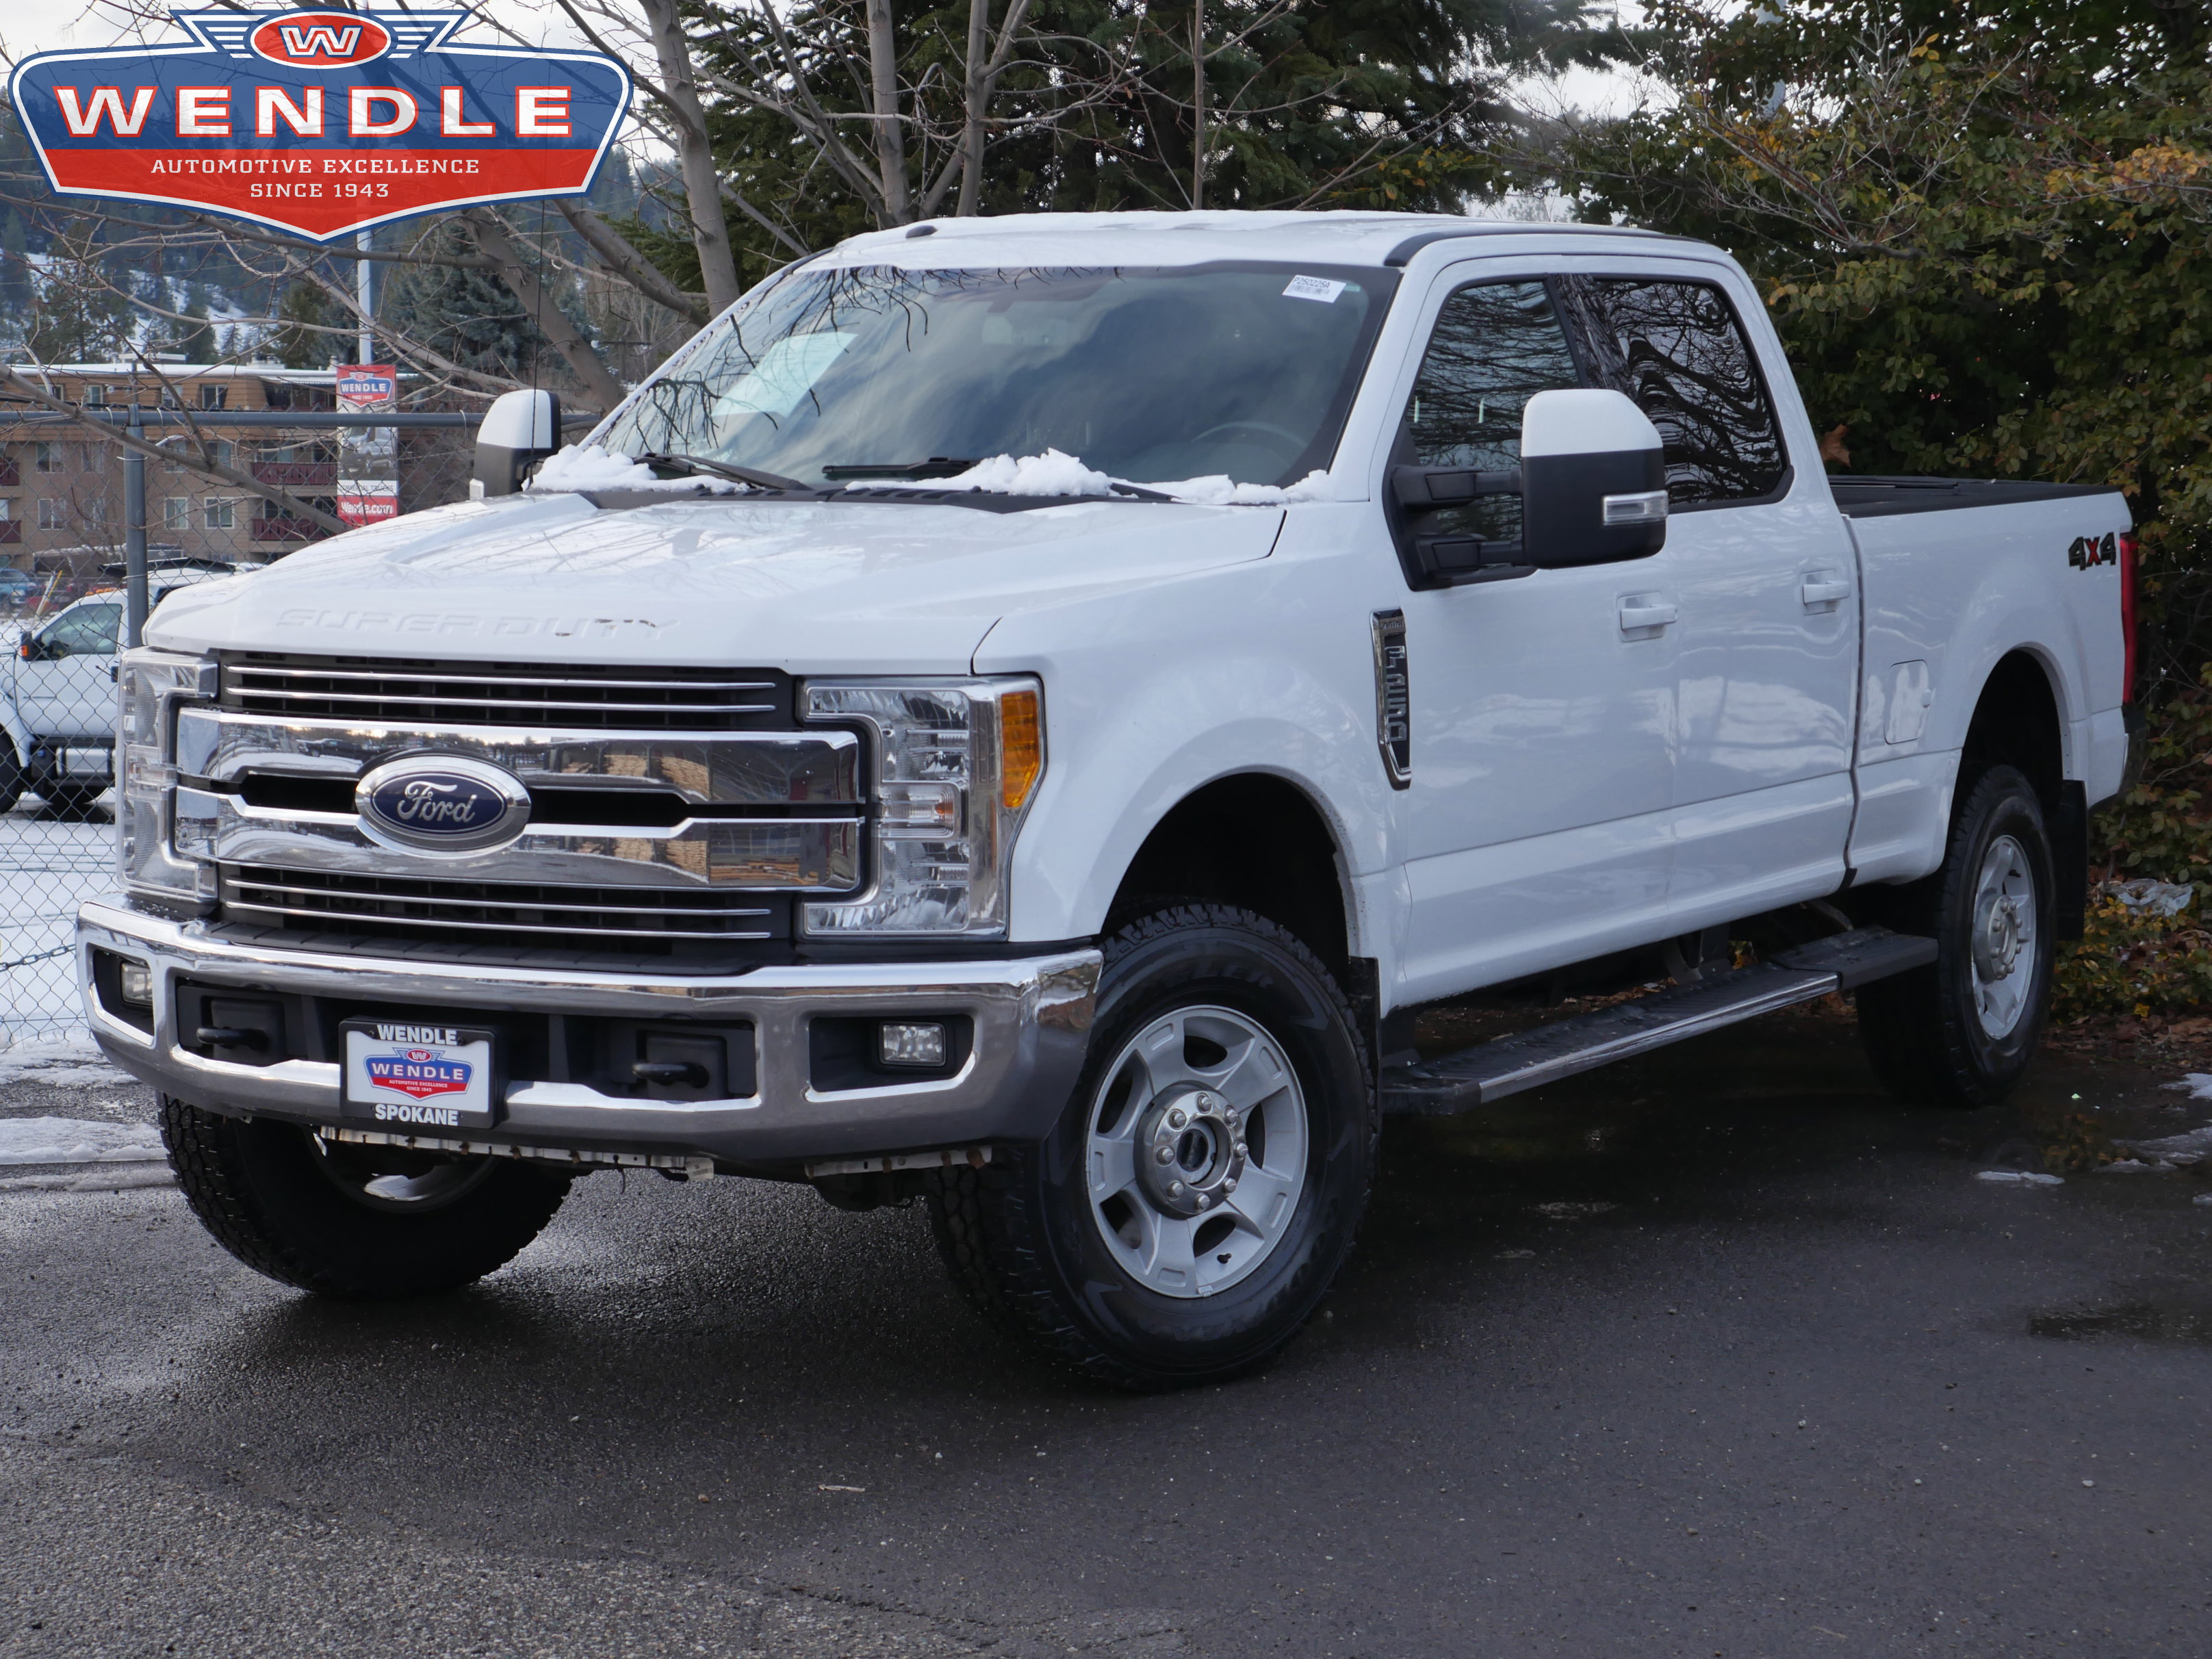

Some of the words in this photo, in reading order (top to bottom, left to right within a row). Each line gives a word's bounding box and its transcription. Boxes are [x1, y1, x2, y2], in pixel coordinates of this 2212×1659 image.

[342, 383, 386, 392] WENDLE
[341, 502, 393, 513] Wende.com
[276, 608, 483, 634] SUPER
[493, 617, 680, 639] DUTY
[397, 781, 478, 823] Ford
[378, 1025, 457, 1045] WENDLE
[372, 1063, 463, 1080] WENDLE
[375, 1104, 458, 1126] SPOKANE
